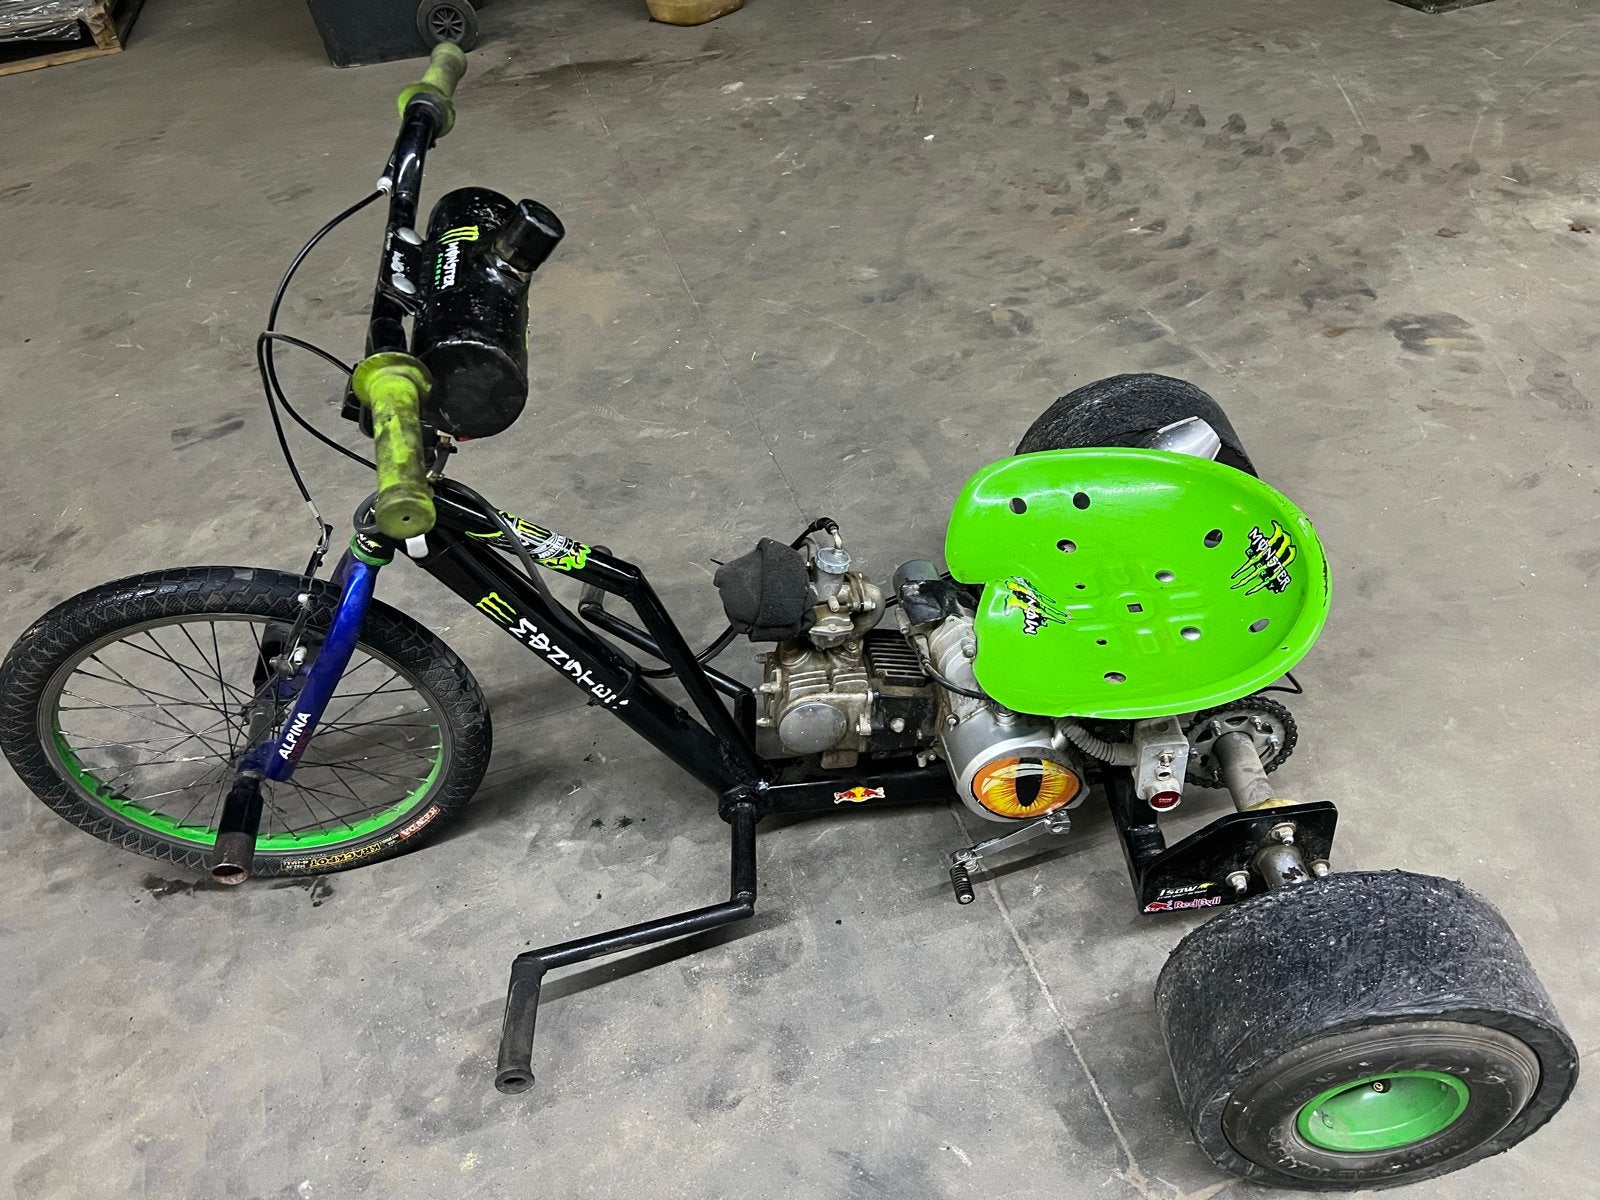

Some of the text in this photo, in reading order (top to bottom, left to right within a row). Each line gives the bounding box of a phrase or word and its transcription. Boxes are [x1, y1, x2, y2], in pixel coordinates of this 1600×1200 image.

[278, 712, 312, 760] ALPINA
[399, 804, 439, 838] KENDA
[309, 841, 381, 869] KRACKPOT
